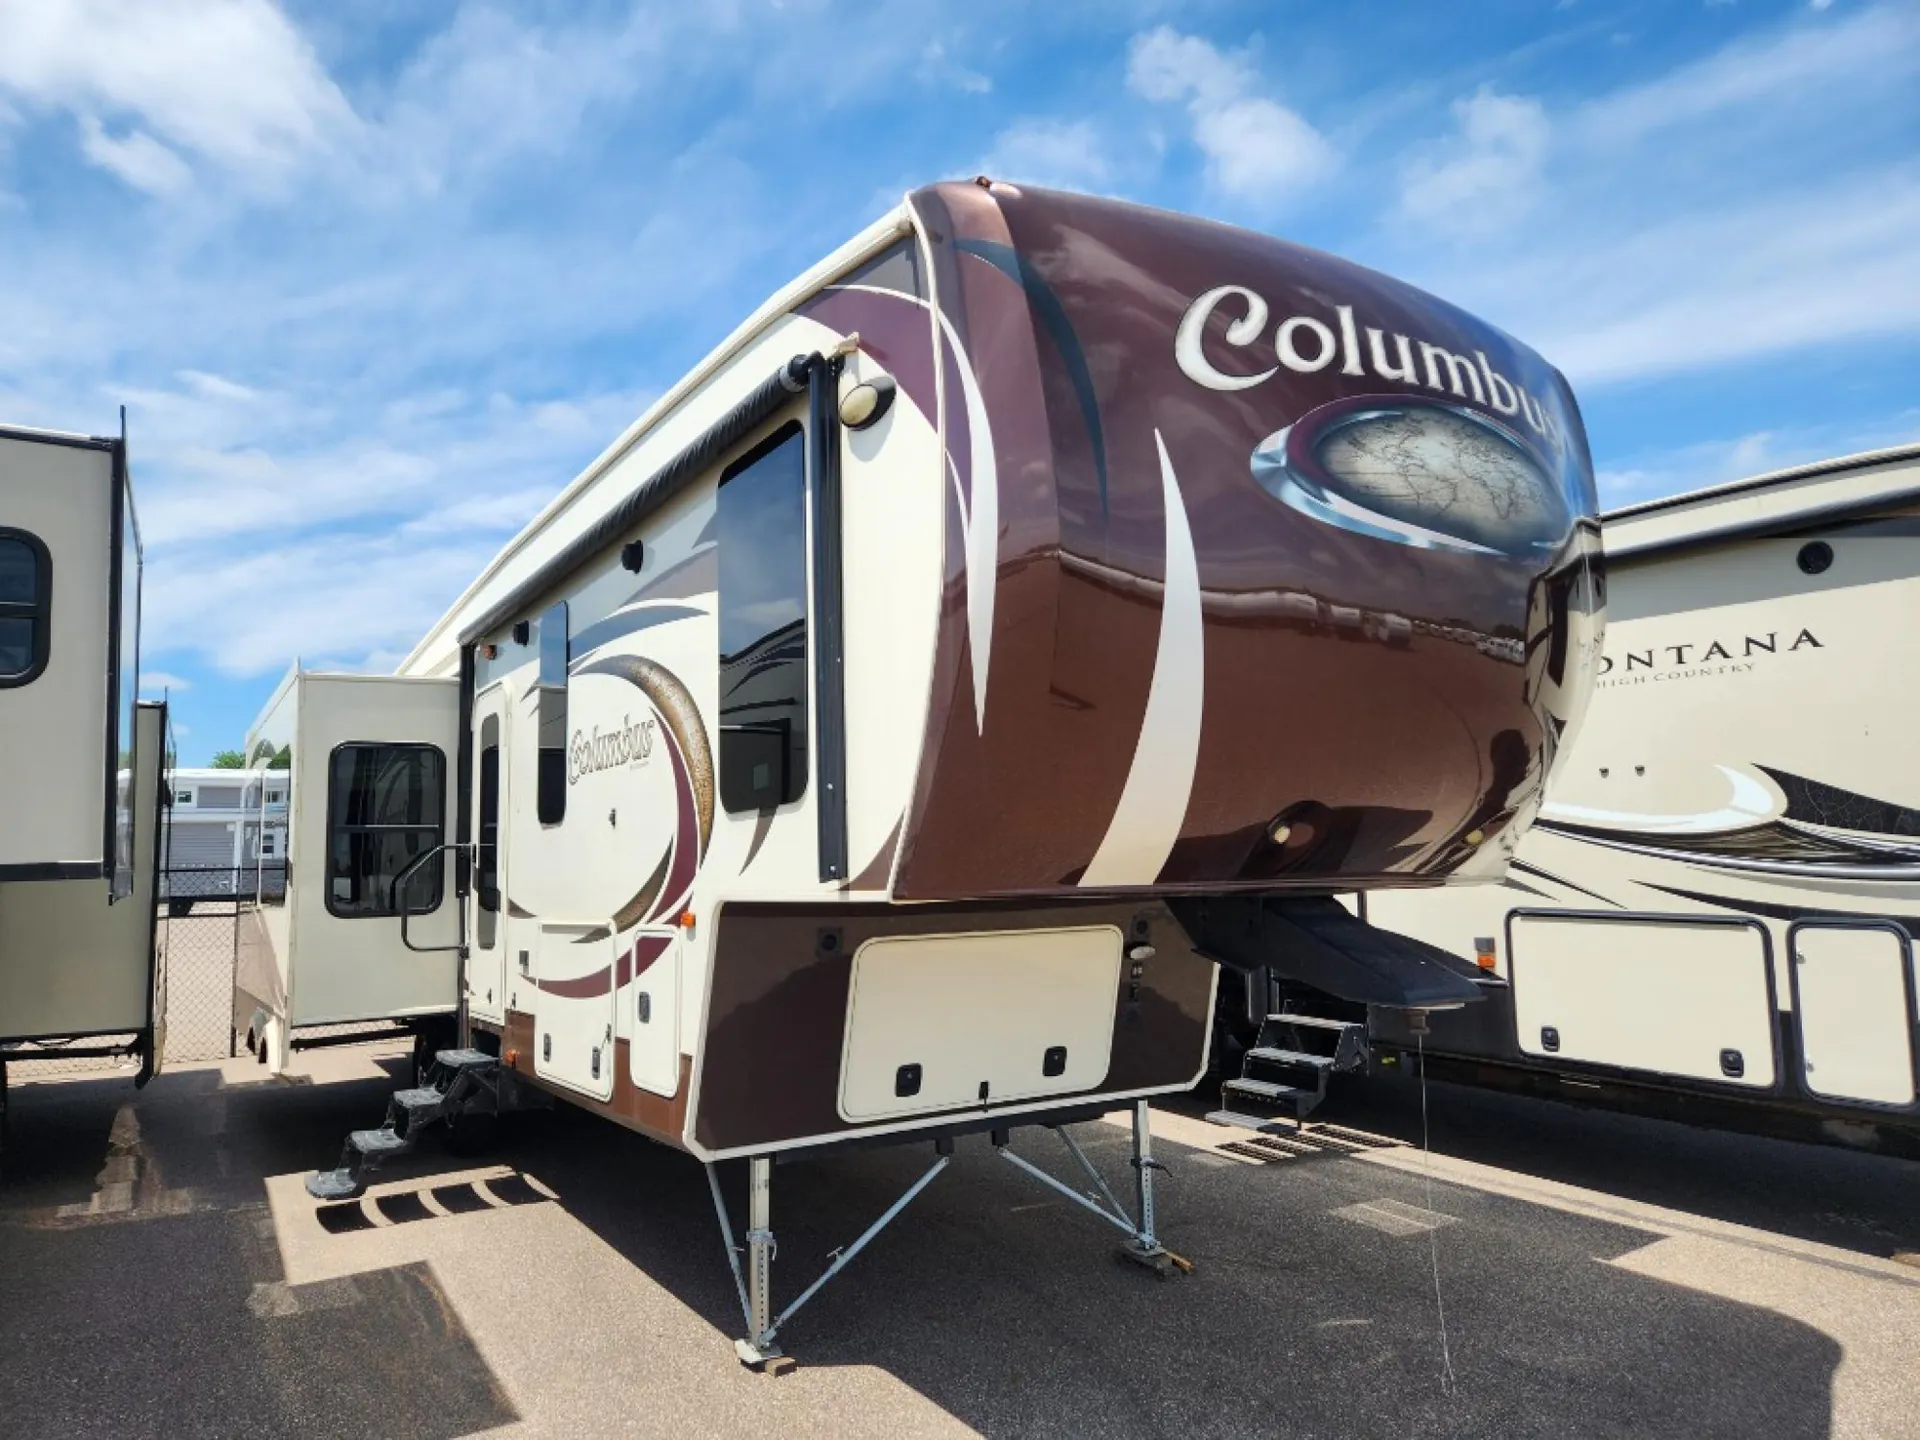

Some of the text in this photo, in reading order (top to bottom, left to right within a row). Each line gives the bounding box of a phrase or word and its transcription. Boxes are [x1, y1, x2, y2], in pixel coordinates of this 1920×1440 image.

[1174, 284, 1563, 454] Columbus
[1597, 628, 1824, 676] ONTANA
[1653, 662, 1756, 682] COUNTRY
[568, 712, 655, 786] Columbus
